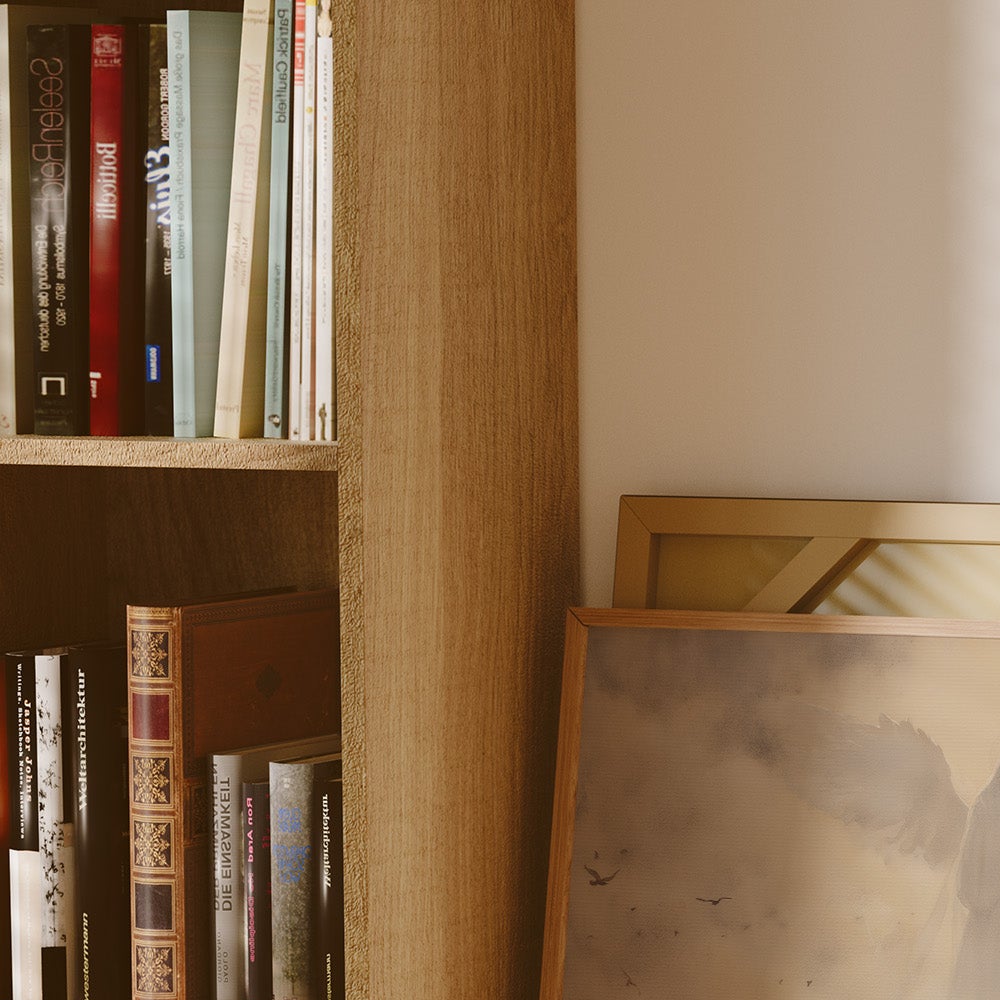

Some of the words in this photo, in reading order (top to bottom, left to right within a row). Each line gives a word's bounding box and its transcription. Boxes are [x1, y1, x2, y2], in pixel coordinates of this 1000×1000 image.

[23, 699, 32, 752] Jasper
[77, 668, 87, 811] Weltarchitektur
[25, 756, 33, 802] Johns
